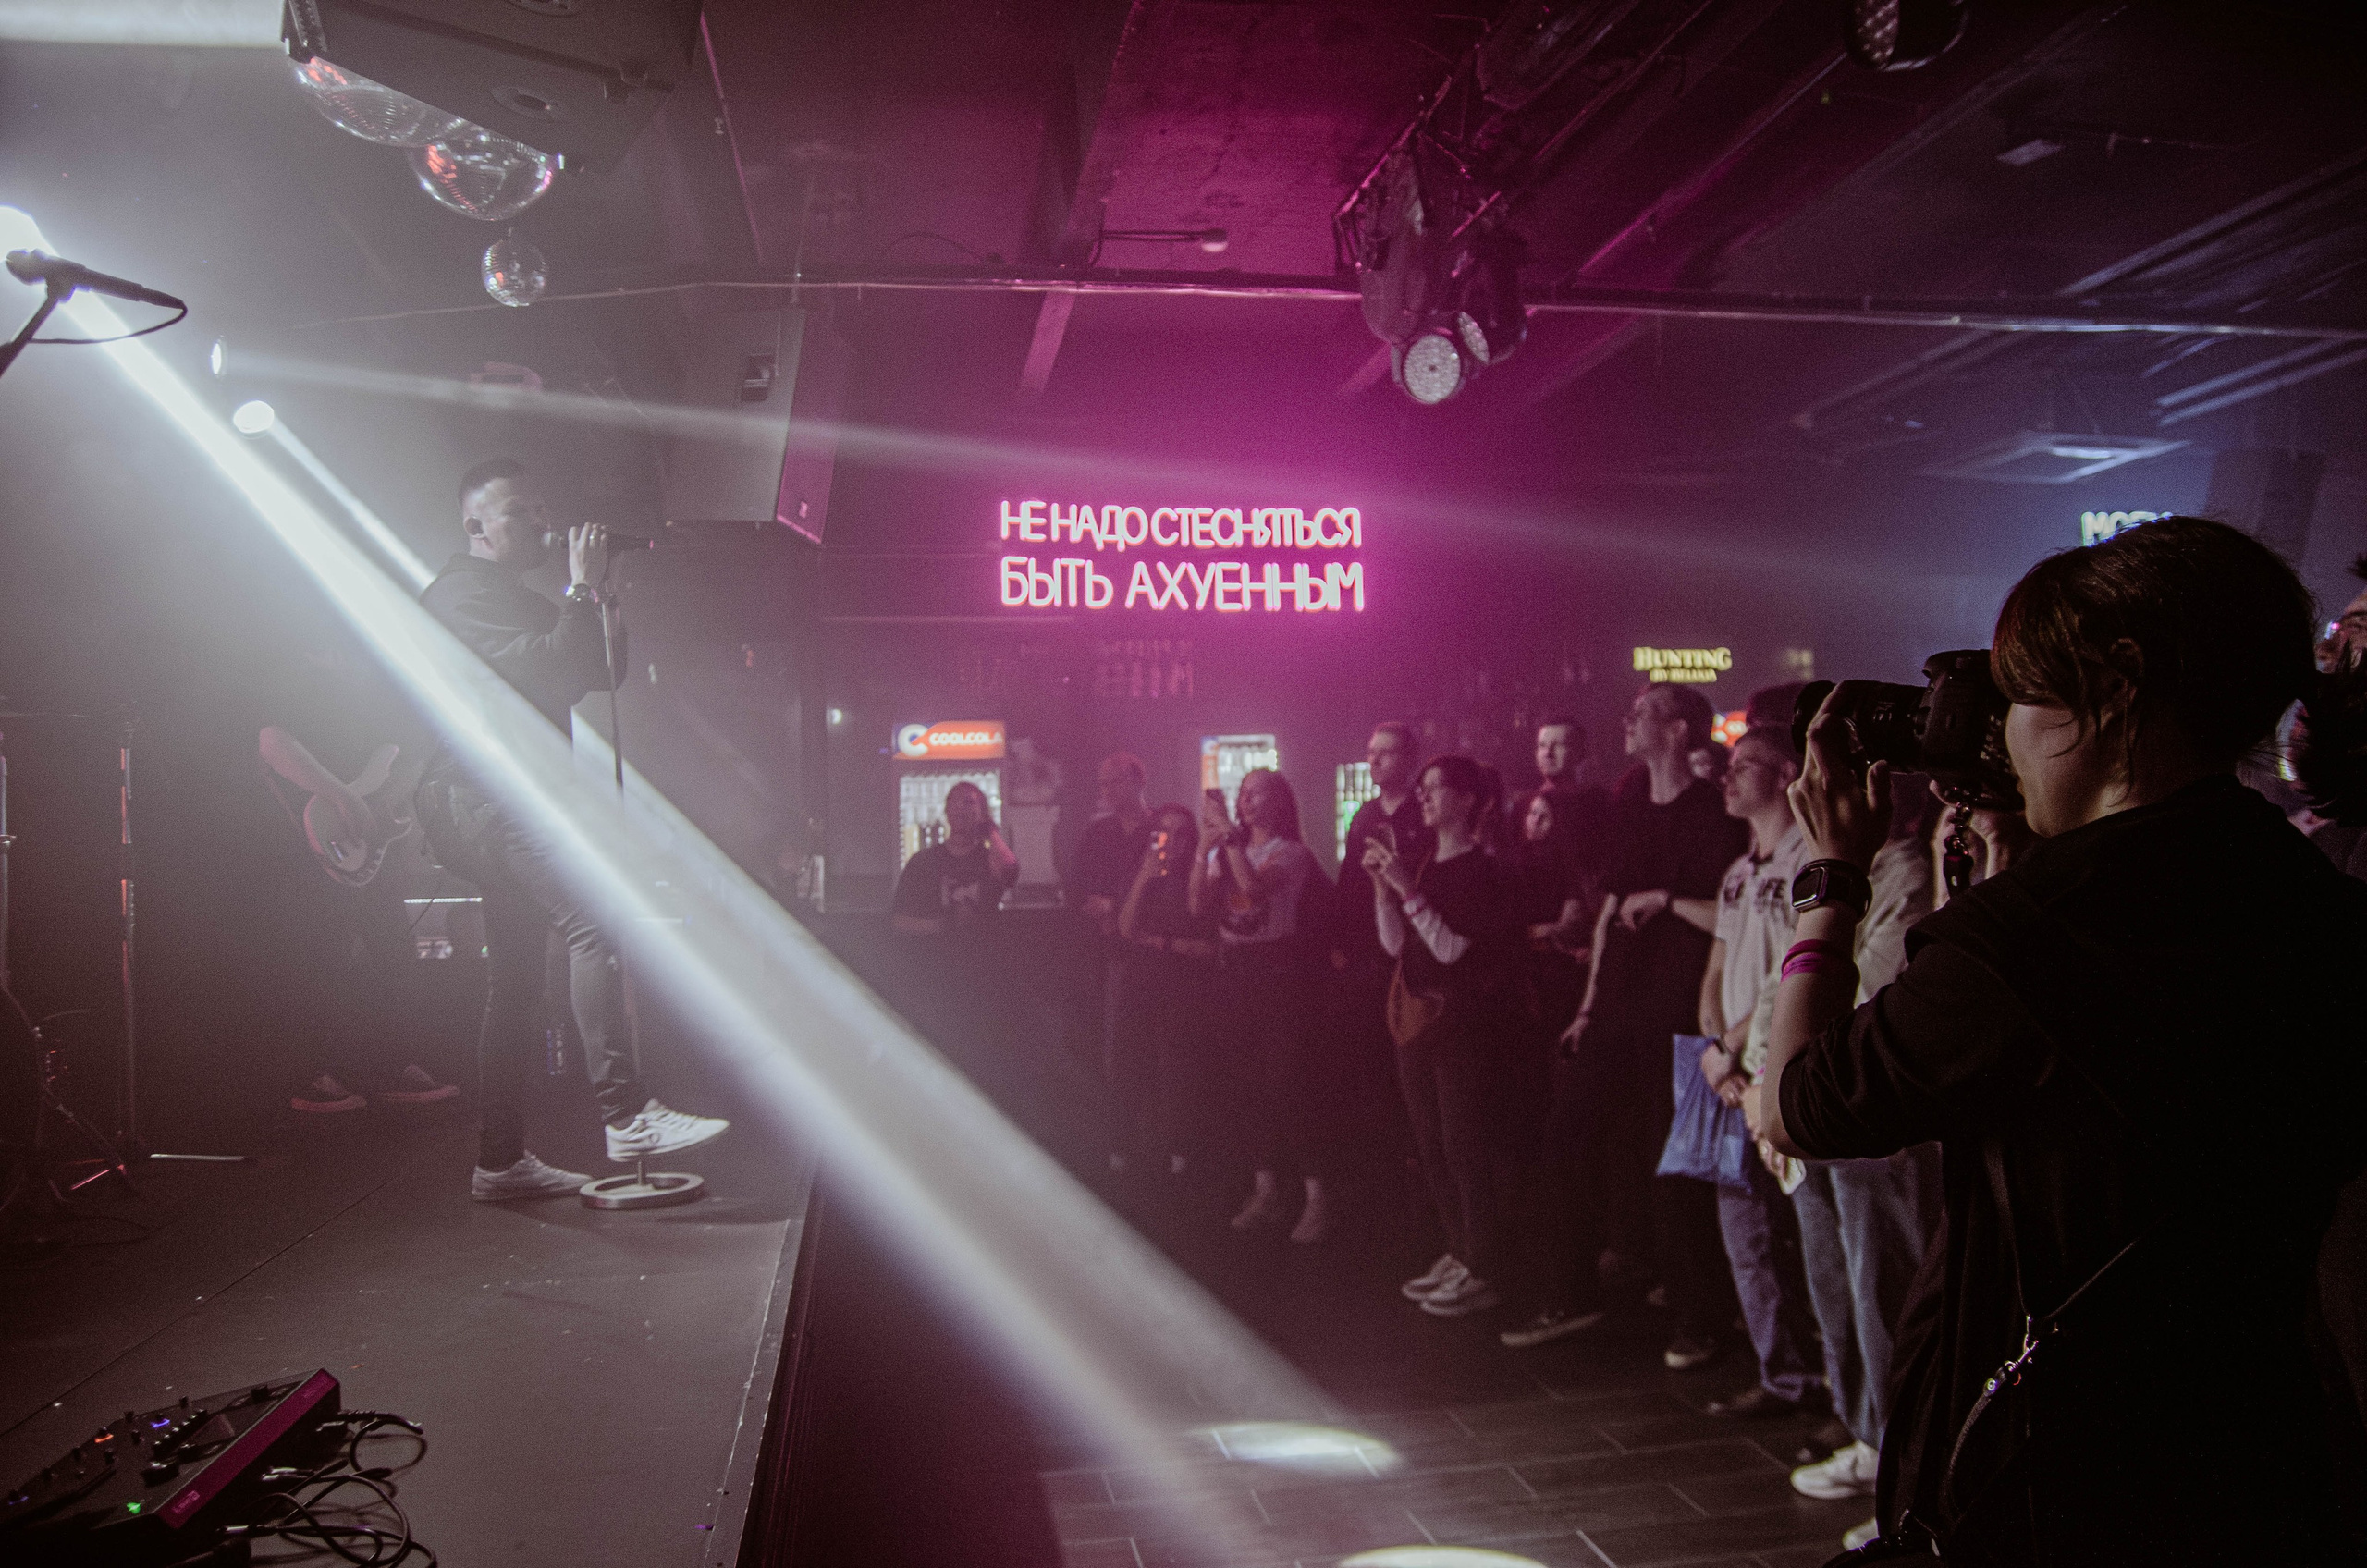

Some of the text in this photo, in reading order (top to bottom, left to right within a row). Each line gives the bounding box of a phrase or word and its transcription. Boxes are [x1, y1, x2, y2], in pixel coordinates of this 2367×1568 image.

[1000, 500, 1363, 552] НЕ НАДО СТЕСНЯТЬСЯ
[1000, 555, 1365, 612] БЫТЬ АХУЕННЫМ
[1633, 646, 1733, 671] HUNTING
[928, 731, 1003, 747] COOLCOLA
